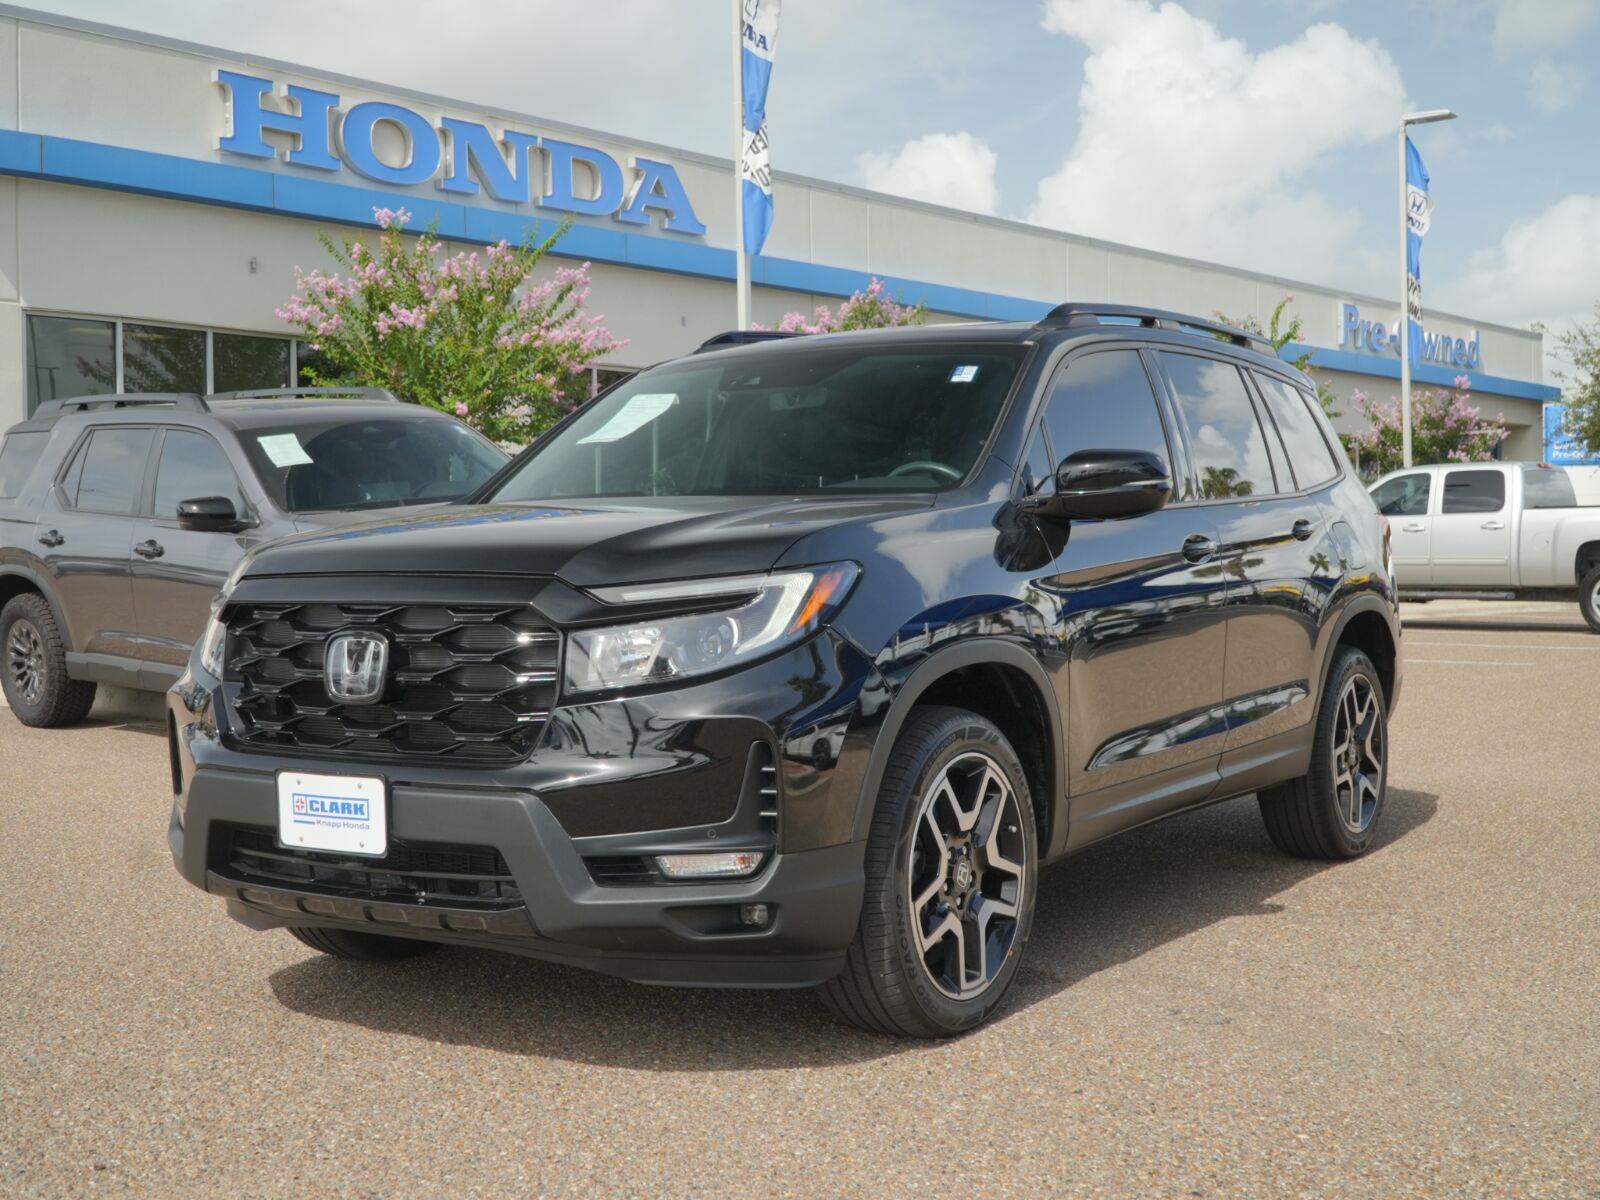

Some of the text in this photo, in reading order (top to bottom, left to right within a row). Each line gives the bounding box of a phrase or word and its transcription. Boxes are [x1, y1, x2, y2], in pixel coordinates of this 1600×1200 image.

[214, 69, 706, 235] HONDA
[1339, 302, 1481, 367] Pre-wned
[308, 799, 366, 816] CLARK
[316, 819, 370, 830] Knapp Honda
